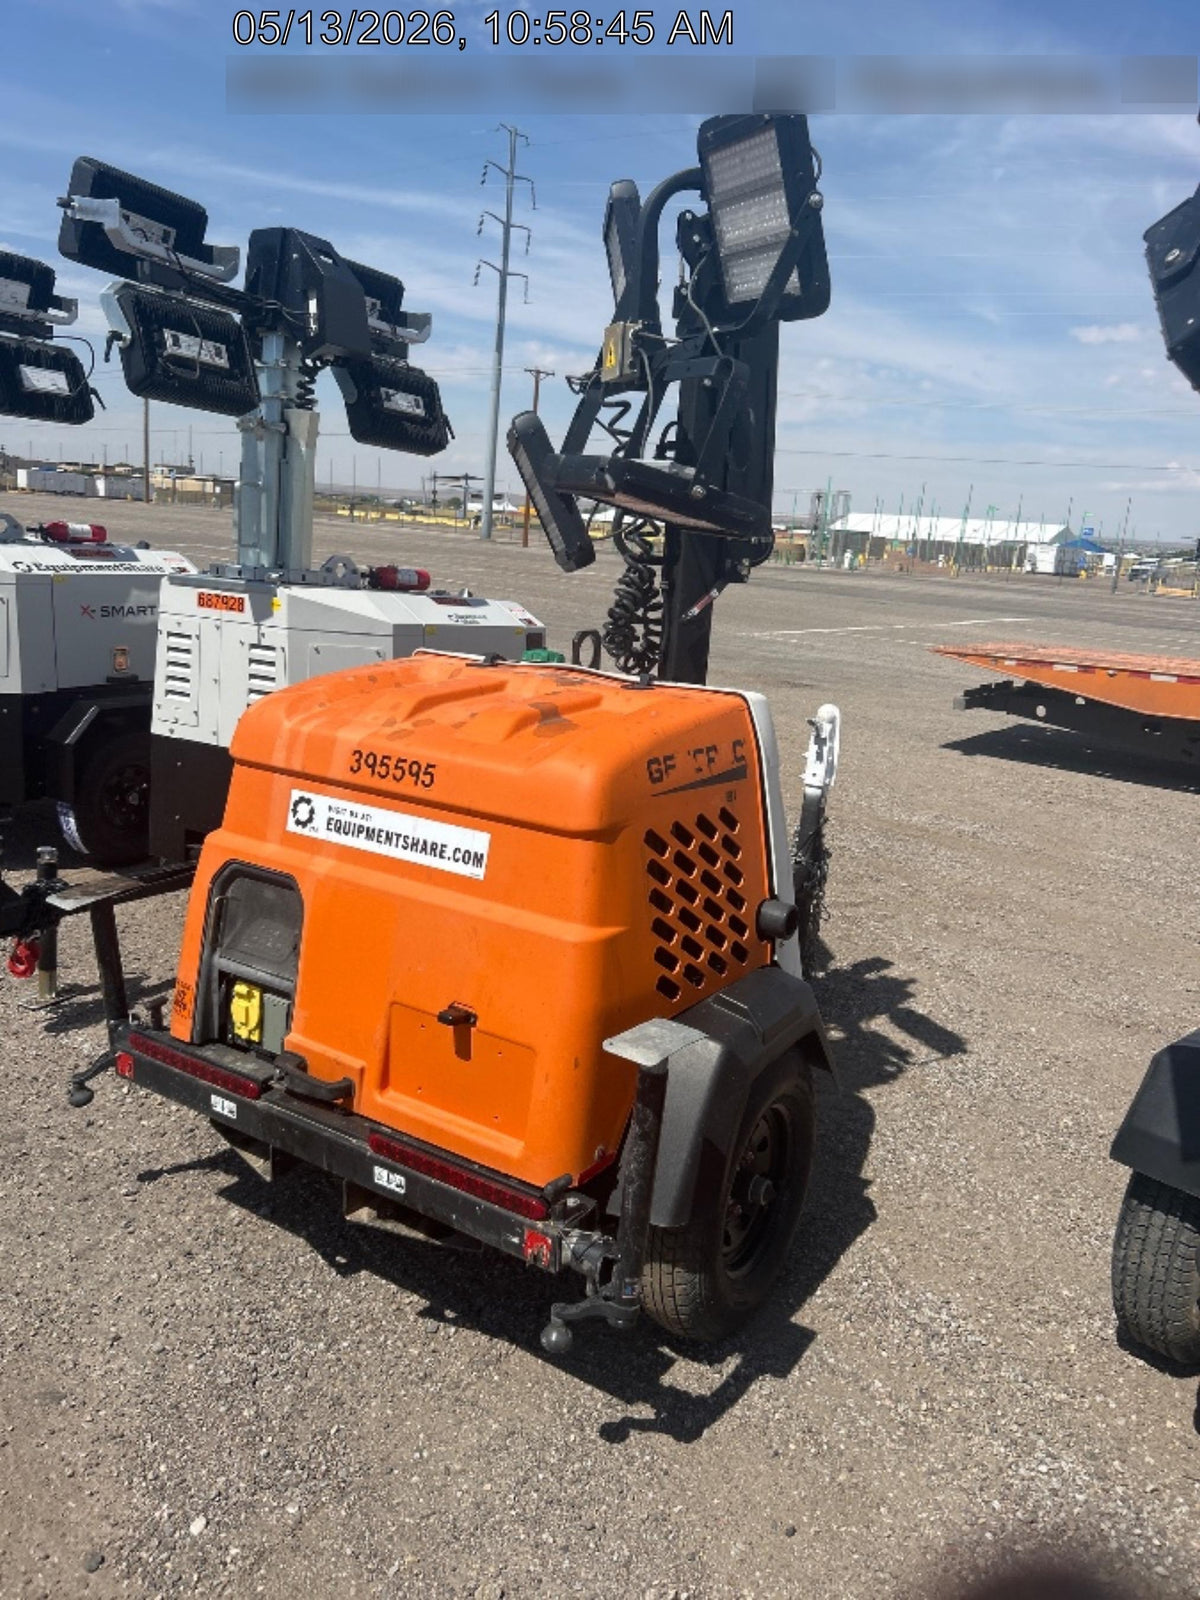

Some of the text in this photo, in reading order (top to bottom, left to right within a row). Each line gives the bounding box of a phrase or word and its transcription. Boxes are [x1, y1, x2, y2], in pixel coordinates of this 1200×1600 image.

[197, 592, 245, 613] 687928
[349, 749, 437, 789] 395595
[325, 816, 485, 869] EQUIPMENTSHARE.COM
